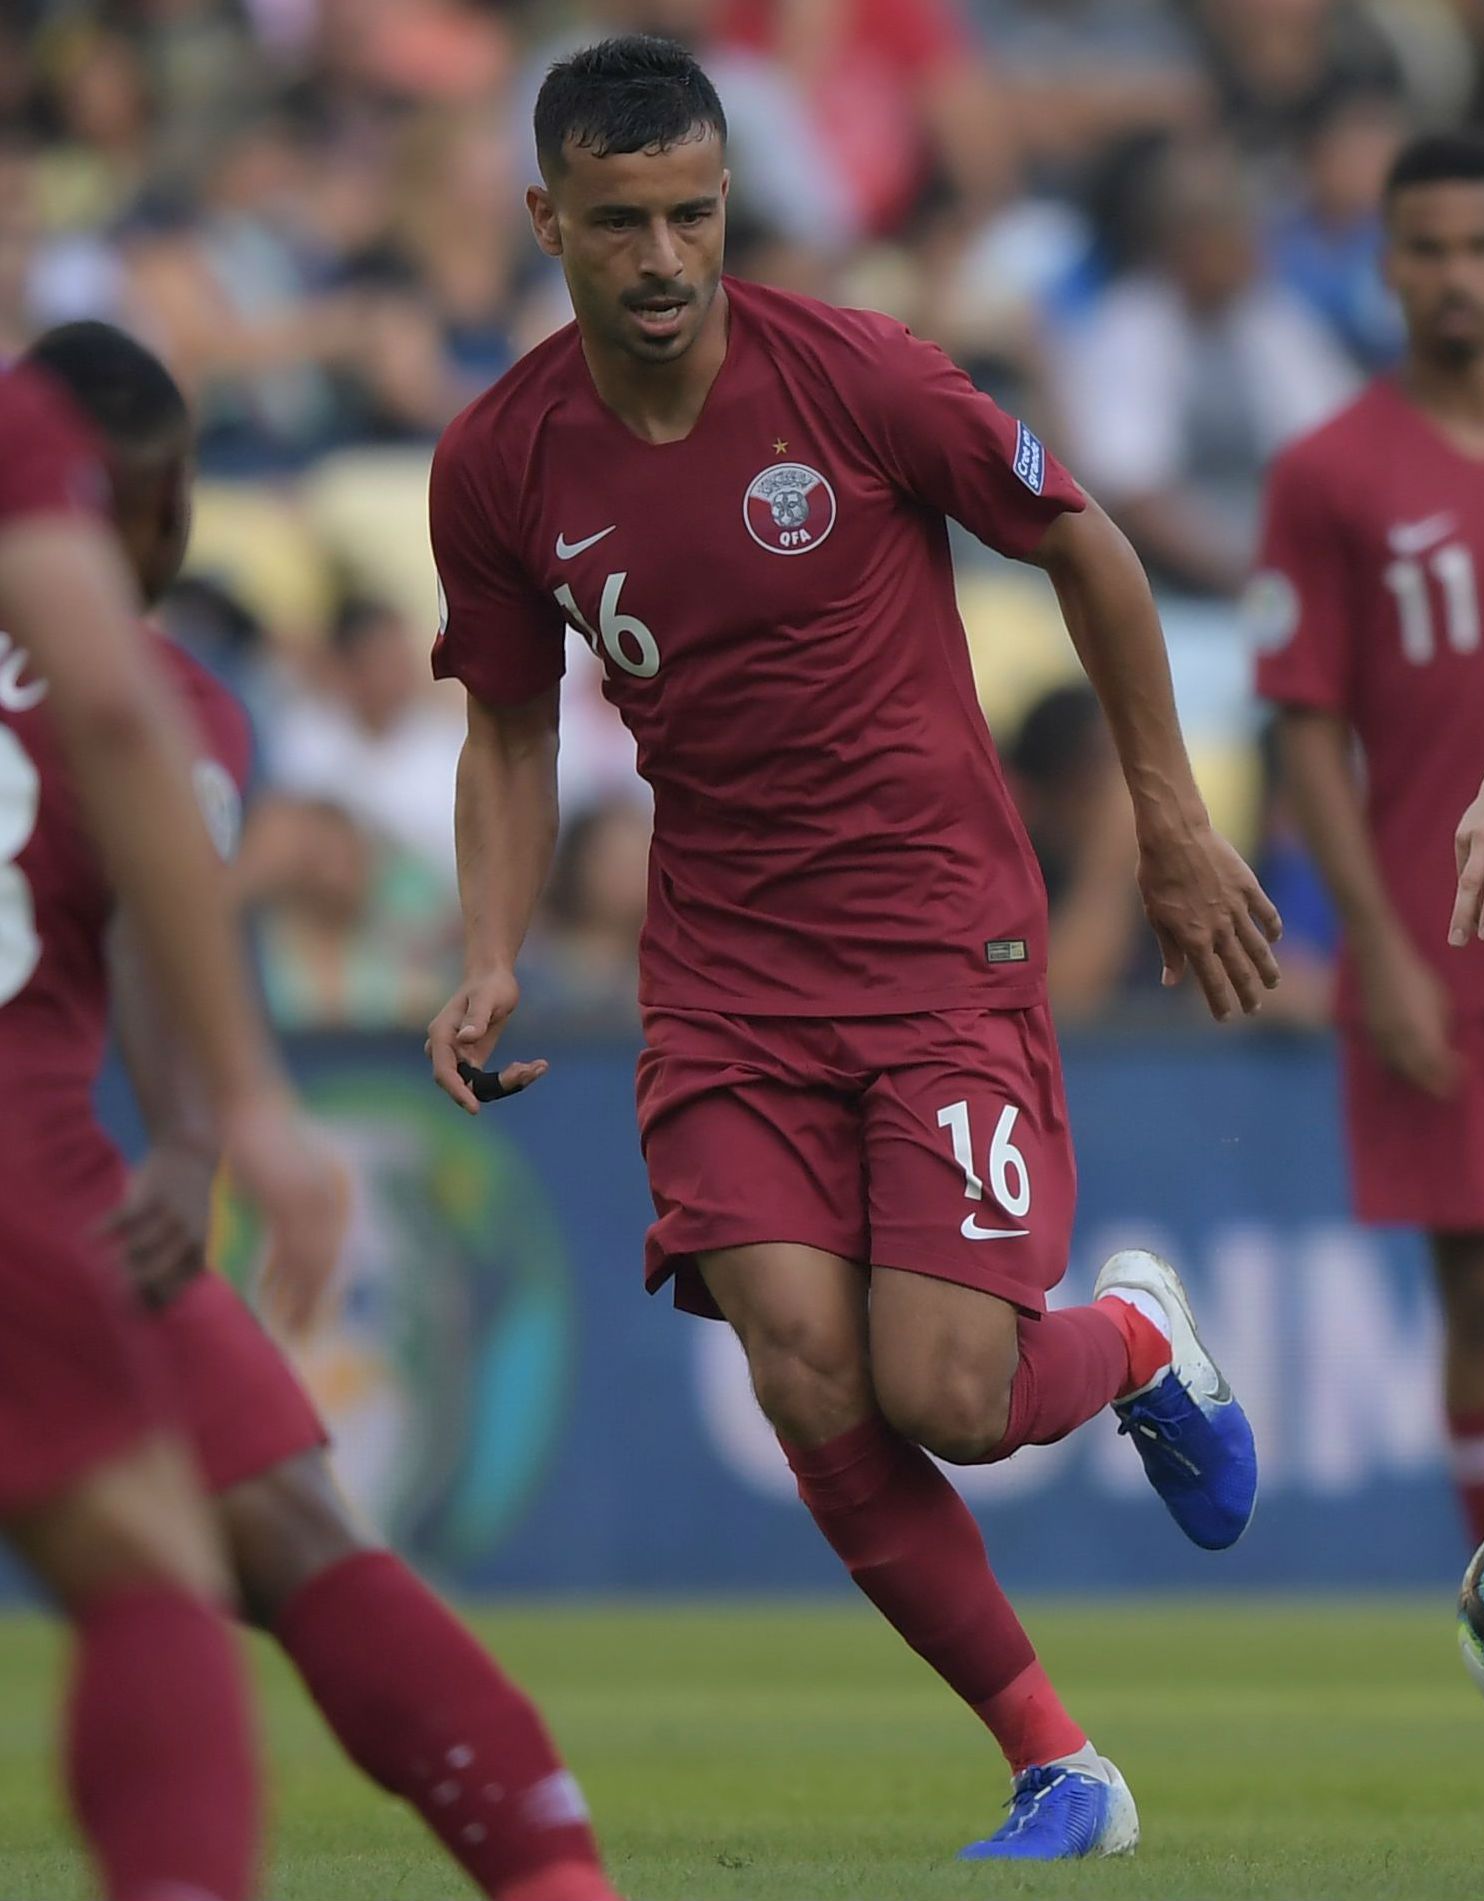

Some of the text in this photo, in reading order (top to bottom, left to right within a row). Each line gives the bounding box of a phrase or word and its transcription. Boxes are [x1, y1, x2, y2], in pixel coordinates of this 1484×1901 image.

[779, 528, 812, 547] QFA
[553, 571, 660, 680] 16
[1387, 543, 1483, 667] 11
[937, 1100, 1031, 1217] 16
